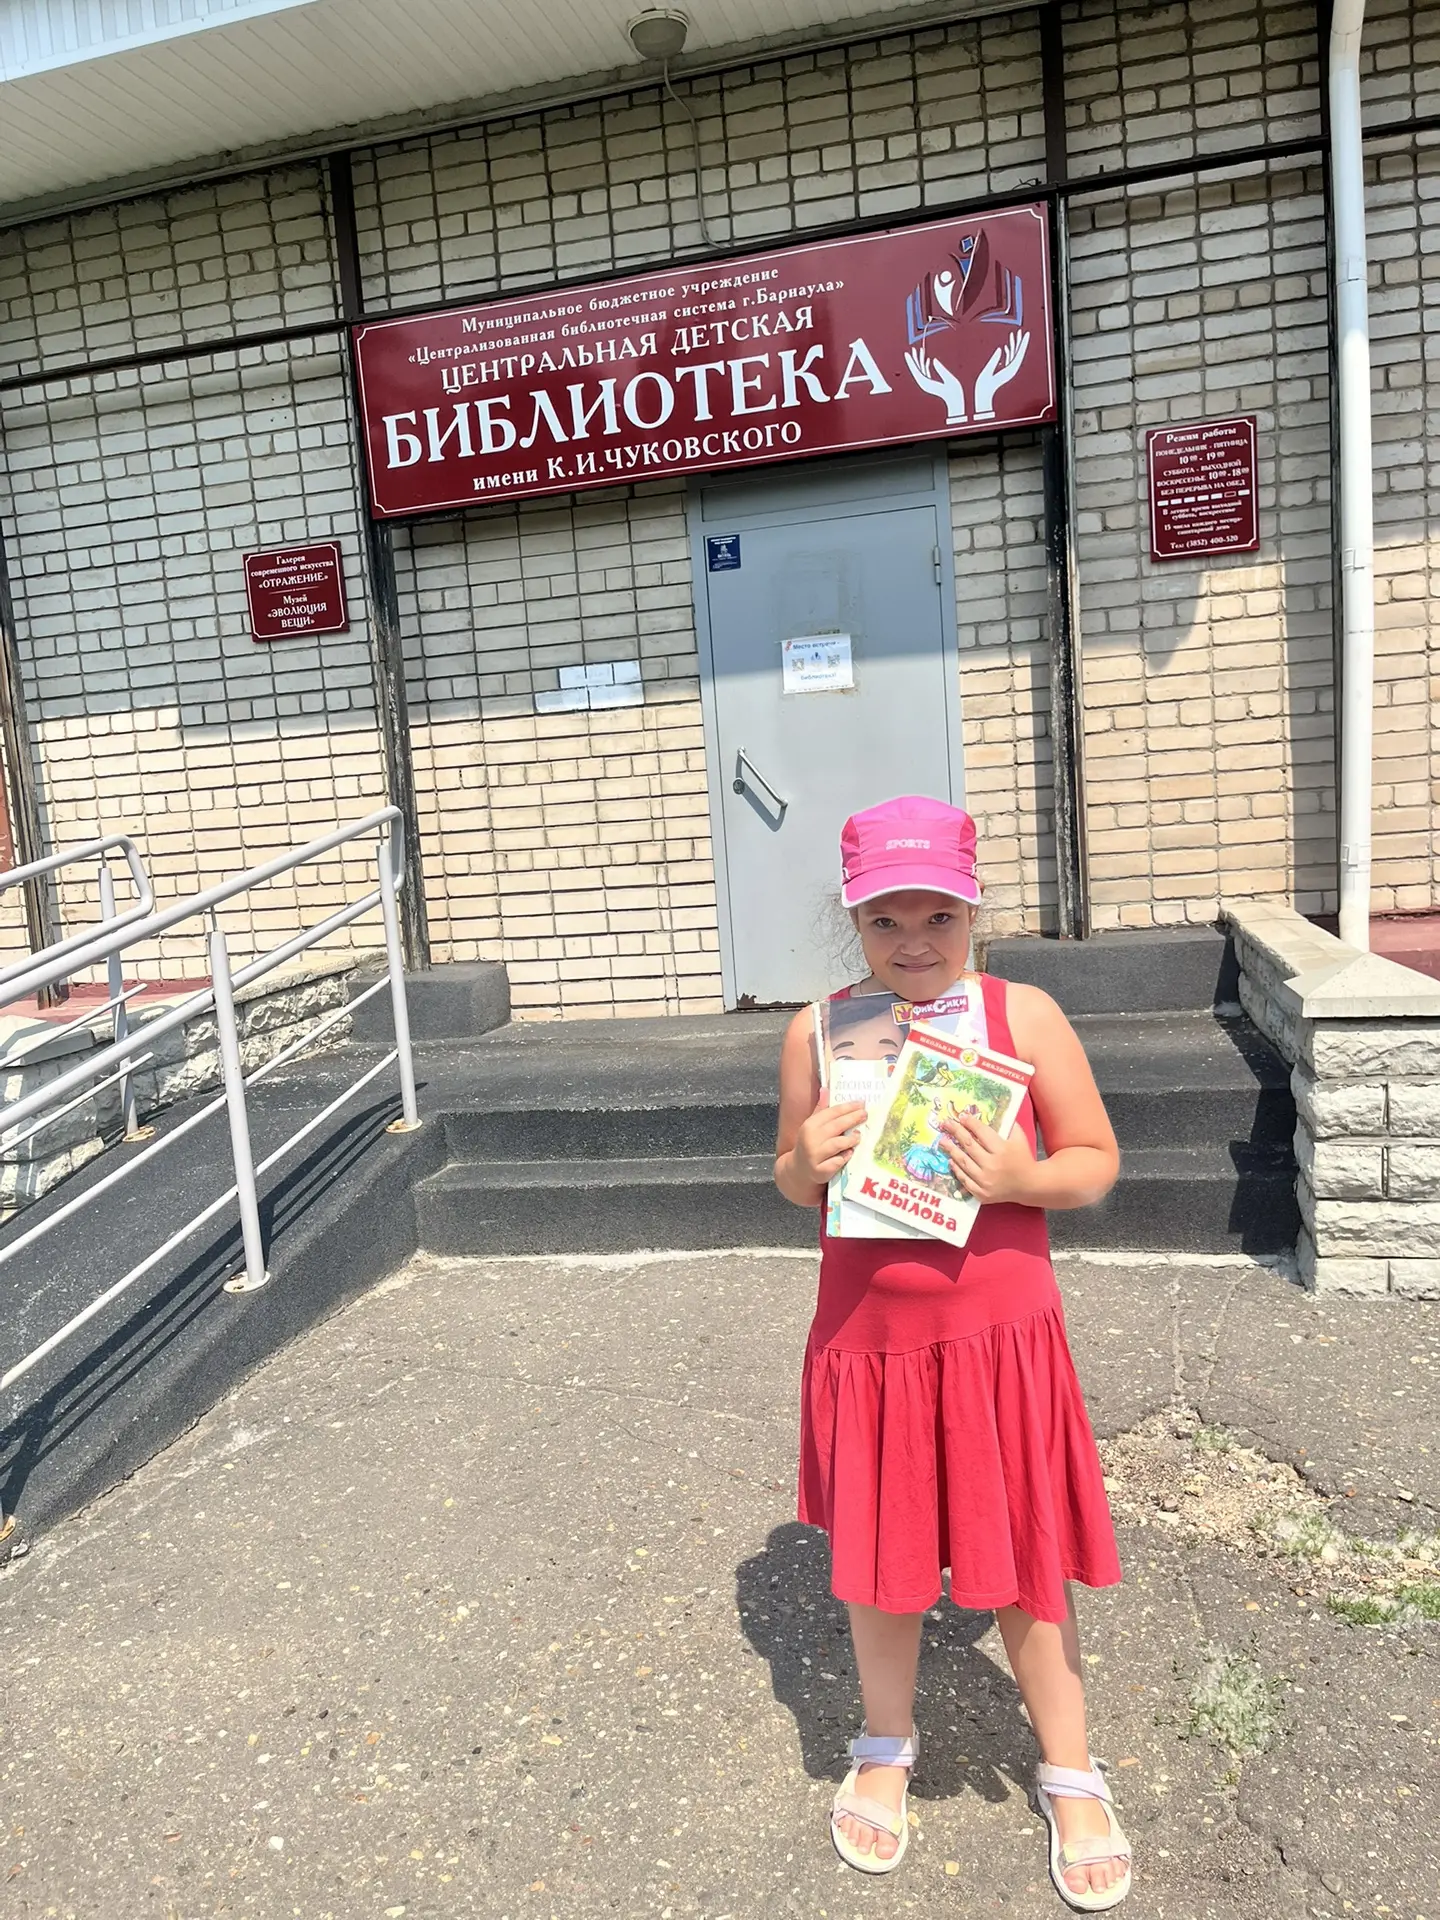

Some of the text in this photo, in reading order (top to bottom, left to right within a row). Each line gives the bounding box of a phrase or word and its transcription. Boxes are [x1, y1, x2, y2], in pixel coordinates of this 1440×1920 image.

[462, 269, 779, 334] Муниципальное бюджетное учреждение
[408, 280, 845, 365] «Централизованная библиотечная система г.Барнаула»
[441, 306, 814, 395] ЦЕНТРАЛЬНАЯ ДЕТСКАЯ
[381, 337, 893, 470] БИБЛИОТЕКА
[1166, 428, 1237, 443] Режим работы
[473, 421, 802, 491] имени К.И.ЧУКОВСКОГО
[1155, 444, 1207, 457] ПОНЕДЕЛЬНИК
[1213, 438, 1248, 449] ПЯТНИЦА
[1163, 467, 1195, 477] СУББОТА
[1200, 459, 1242, 471] ВЫХОДНОЙ
[1156, 475, 1207, 487] ВОСКРЕСЕНЬЕ
[1161, 488, 1174, 496] БЕЗ
[1175, 484, 1212, 494] ПЕРЕРЫВА
[1226, 479, 1246, 487] ОБЕД
[250, 560, 334, 577] современного искусства
[276, 555, 306, 565] Галерея
[258, 572, 329, 589] «ОТРАЖЕНИЕ»
[283, 594, 308, 606] Музей
[267, 602, 327, 618] «ЭВОЛЮЦИЯ
[281, 617, 315, 629] ВЕЩИ»
[886, 838, 931, 851] SPORTS
